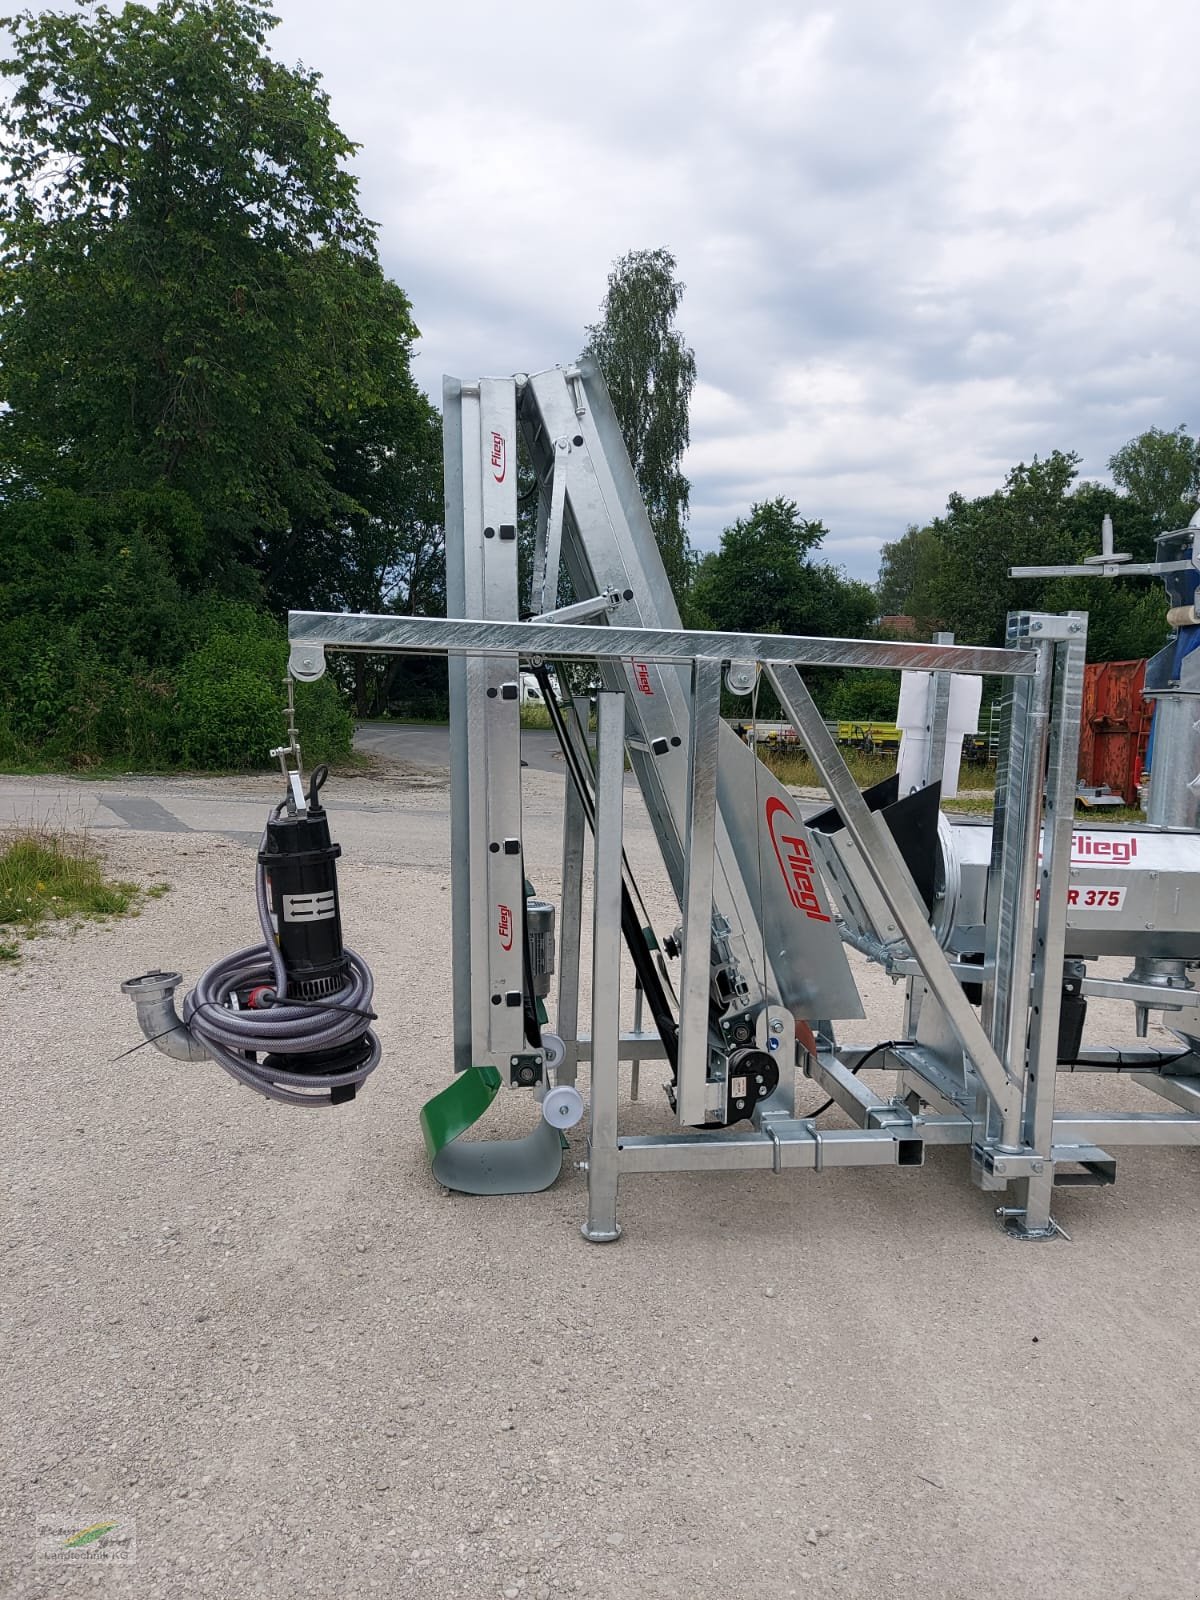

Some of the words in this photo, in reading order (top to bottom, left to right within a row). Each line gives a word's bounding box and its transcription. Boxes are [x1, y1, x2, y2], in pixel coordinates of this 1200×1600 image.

[637, 664, 654, 695] Fliegl
[781, 835, 831, 923] Fliegl
[1084, 890, 1121, 906] 375
